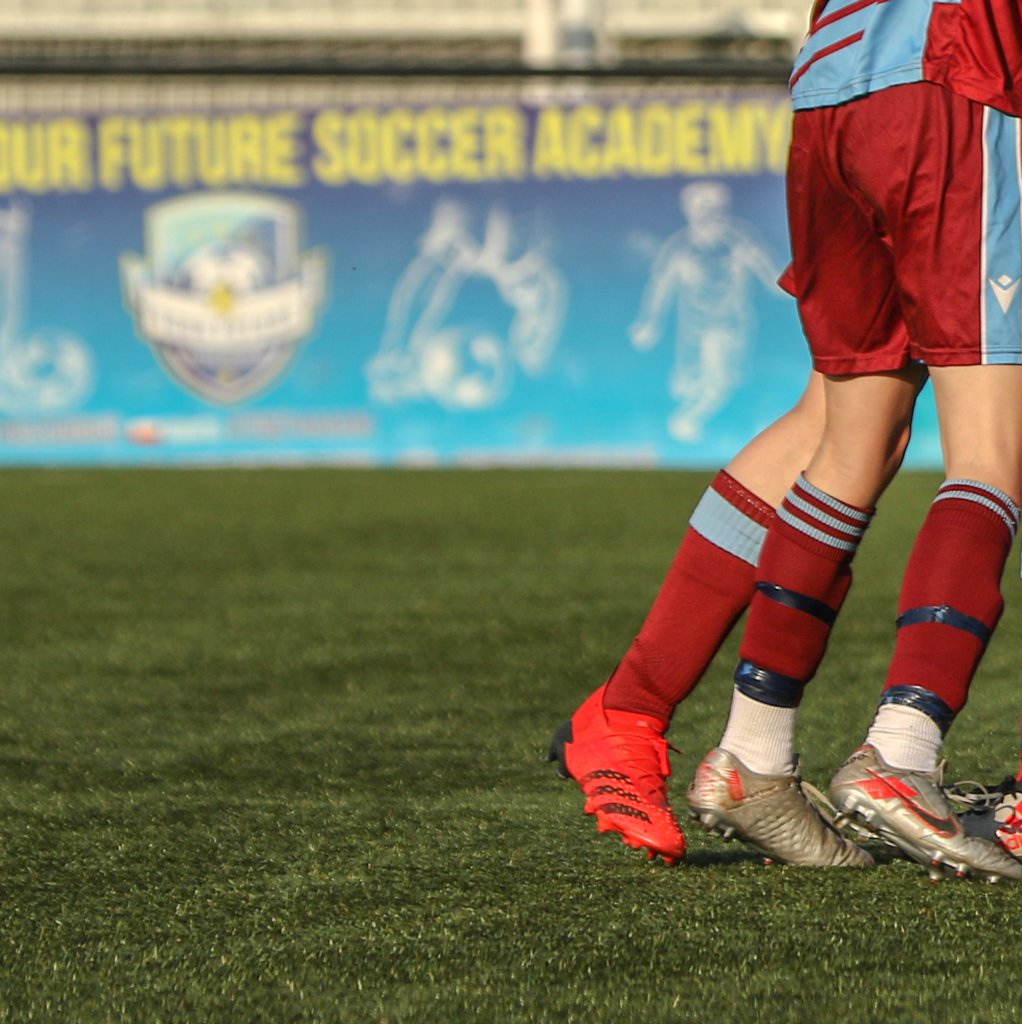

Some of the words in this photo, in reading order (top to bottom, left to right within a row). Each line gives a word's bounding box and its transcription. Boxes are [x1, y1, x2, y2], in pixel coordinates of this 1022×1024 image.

[99, 113, 305, 192] FUTURE
[311, 107, 524, 185] SOCCER
[532, 98, 792, 181] ACADEMY
